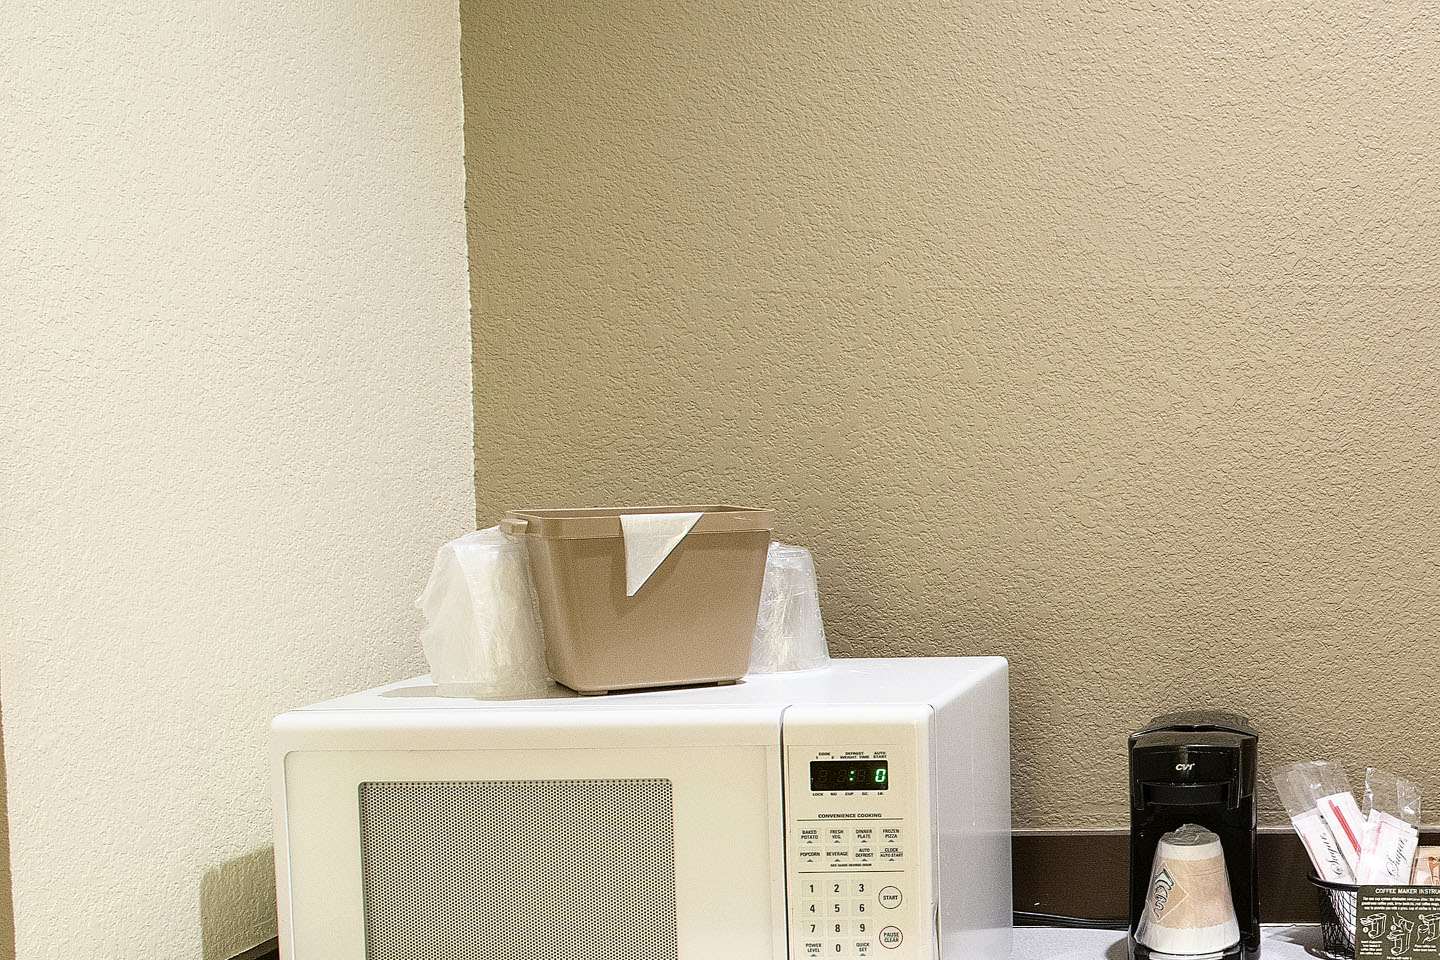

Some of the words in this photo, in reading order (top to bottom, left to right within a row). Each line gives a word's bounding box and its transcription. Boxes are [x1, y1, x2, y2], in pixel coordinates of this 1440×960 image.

[809, 884, 814, 893] 1
[834, 884, 840, 893] 2
[858, 884, 865, 892] 3
[809, 904, 815, 913] 4
[834, 904, 840, 912] 5
[859, 904, 865, 912] 6
[810, 924, 816, 933] 7
[834, 924, 840, 932] 8
[859, 923, 865, 932] 9
[835, 944, 841, 952] 0
